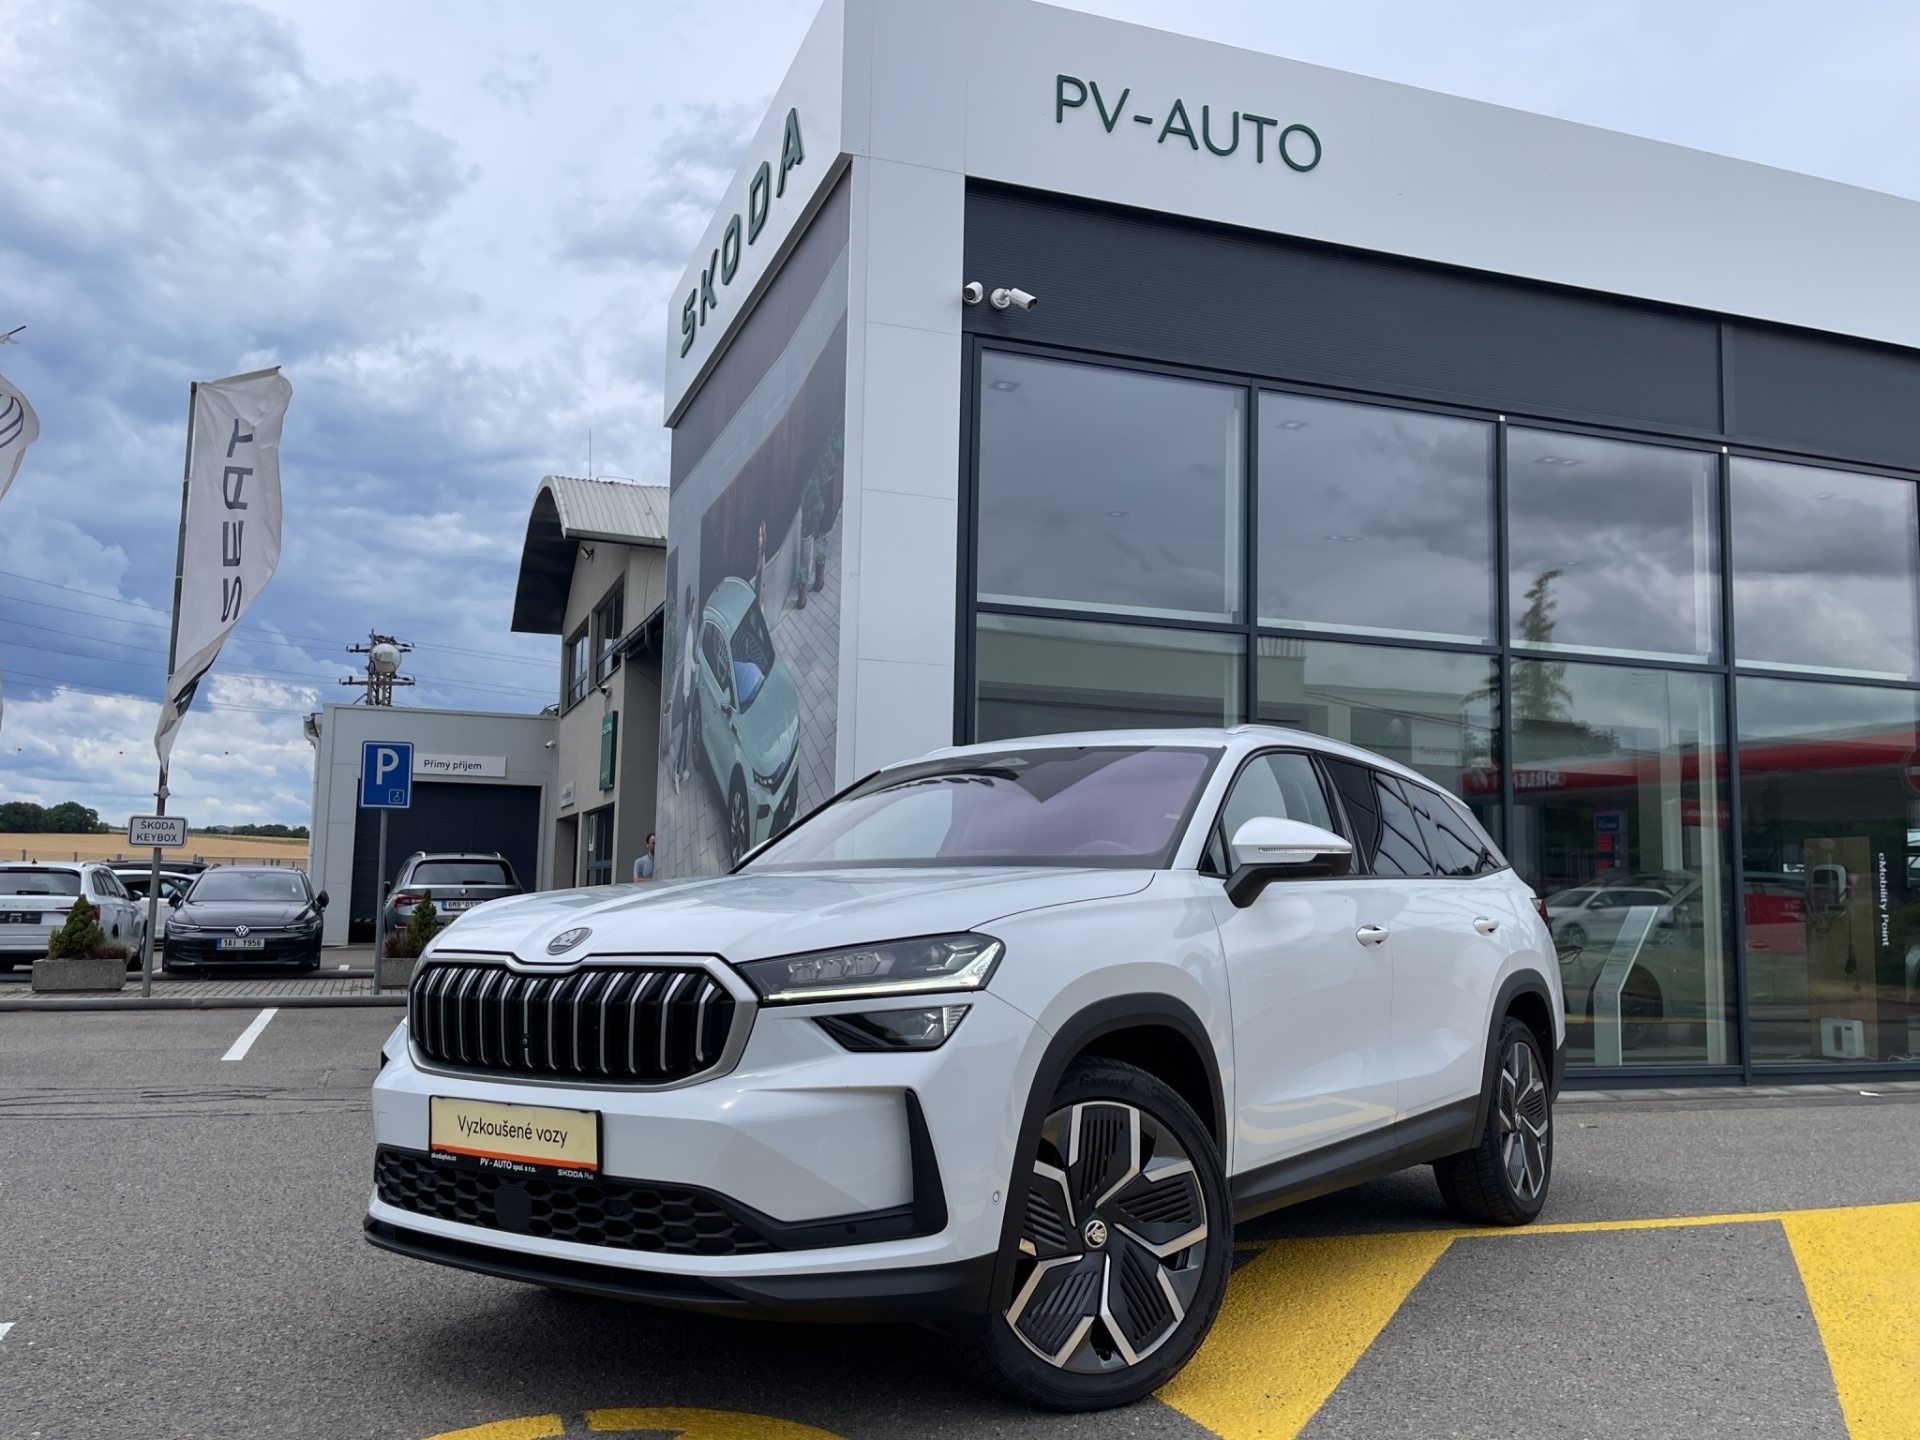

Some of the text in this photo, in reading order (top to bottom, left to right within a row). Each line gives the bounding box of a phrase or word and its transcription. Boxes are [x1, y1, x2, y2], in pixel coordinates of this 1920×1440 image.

[1056, 74, 1322, 172] PV-AUTO
[220, 418, 254, 623] SEAT
[376, 748, 399, 785] P
[136, 833, 177, 842] KEYBOX
[140, 820, 175, 830] ŠKODA
[1878, 852, 1890, 947] eMobility Point
[457, 1115, 568, 1148] Vyzkoušené vozy
[479, 1157, 488, 1167] PV
[493, 1160, 512, 1170] AUTO
